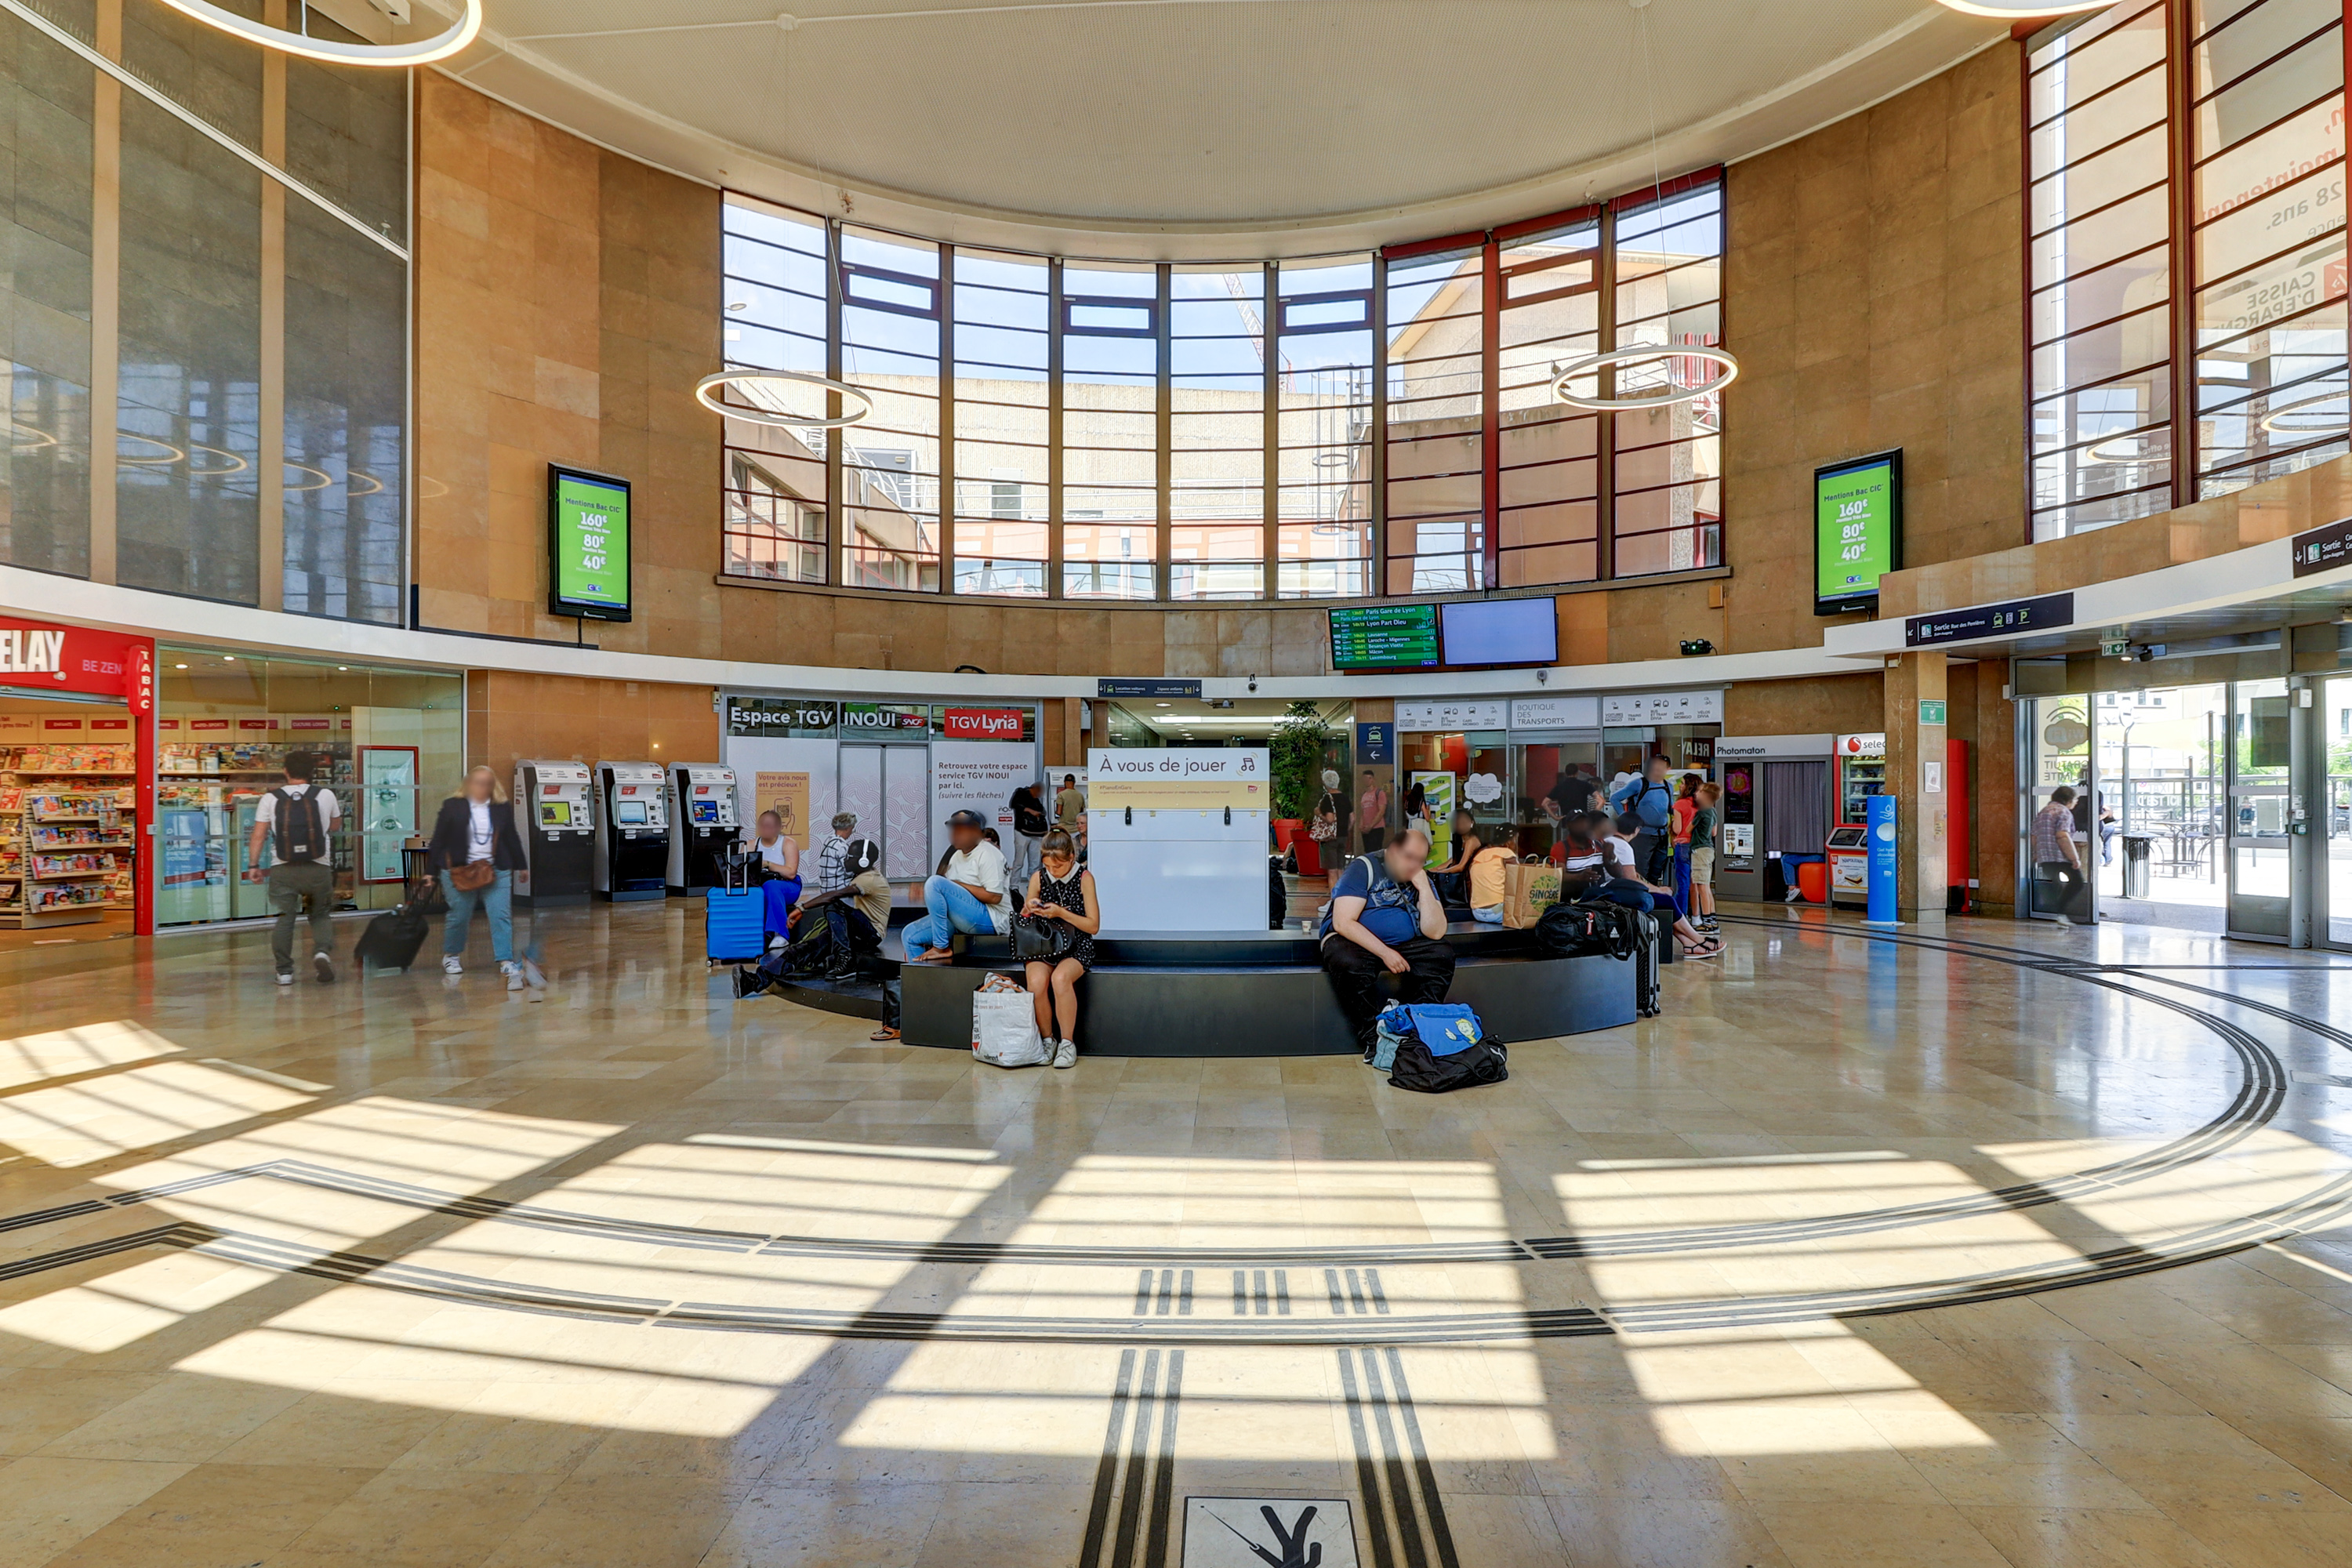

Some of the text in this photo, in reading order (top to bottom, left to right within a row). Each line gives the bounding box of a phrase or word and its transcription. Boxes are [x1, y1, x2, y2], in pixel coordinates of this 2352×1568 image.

[1824, 491, 1854, 503] Mentions
[1855, 488, 1868, 496] Bac
[565, 497, 595, 509] Mentions
[596, 502, 608, 511] Bac
[1839, 498, 1868, 517] 160€
[580, 511, 608, 528] 160€
[1842, 521, 1865, 539] 80€
[583, 534, 605, 548] 80€
[2322, 540, 2341, 552] Sortie
[1841, 543, 1867, 561] 40€
[583, 555, 606, 570] 40€
[1934, 623, 1949, 631] Sortie
[0, 630, 66, 673] ELAY
[82, 659, 122, 675] BE ZEN
[140, 650, 151, 709] TABAC
[730, 706, 923, 727] Espace TGV INOUI SNCF
[1717, 746, 1766, 755] Photomaton
[1863, 740, 1885, 749] selec
[1100, 754, 1227, 776] À vous de jouer
